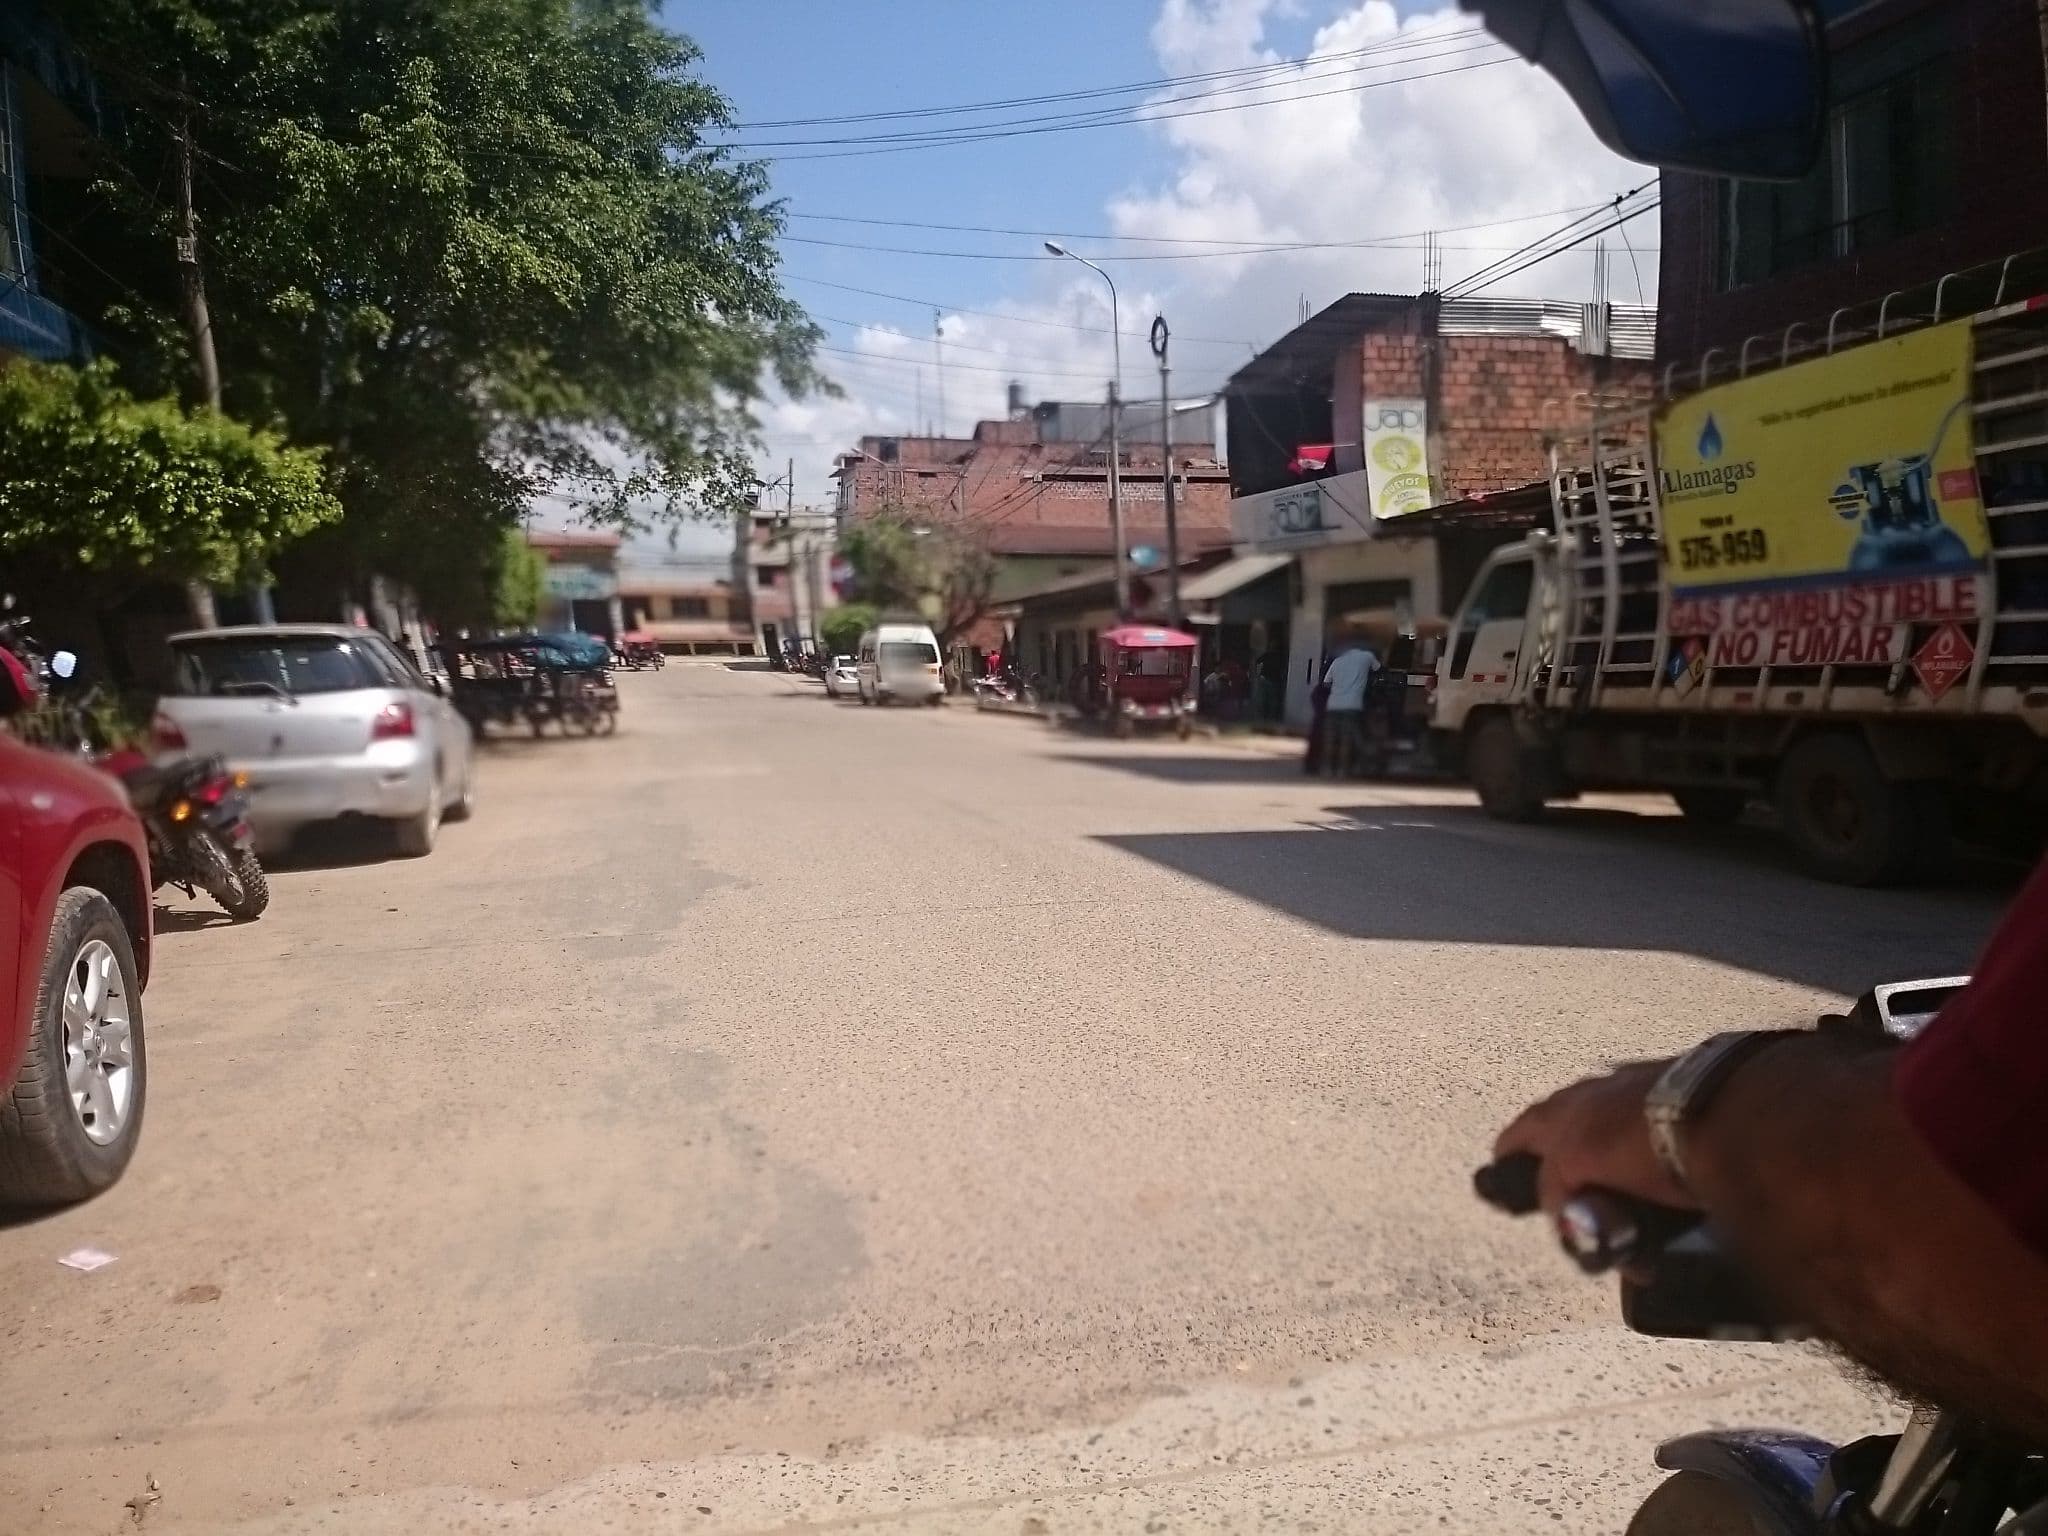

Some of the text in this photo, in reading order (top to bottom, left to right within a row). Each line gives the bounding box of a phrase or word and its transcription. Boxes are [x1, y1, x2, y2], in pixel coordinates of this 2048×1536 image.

[1664, 461, 1756, 494] Llamagas
[1667, 576, 1977, 632] GAS COMBUSTIBLE
[1713, 631, 1758, 666] NO
[1770, 625, 1893, 665] FUMAR
[1934, 671, 1945, 685] 2
